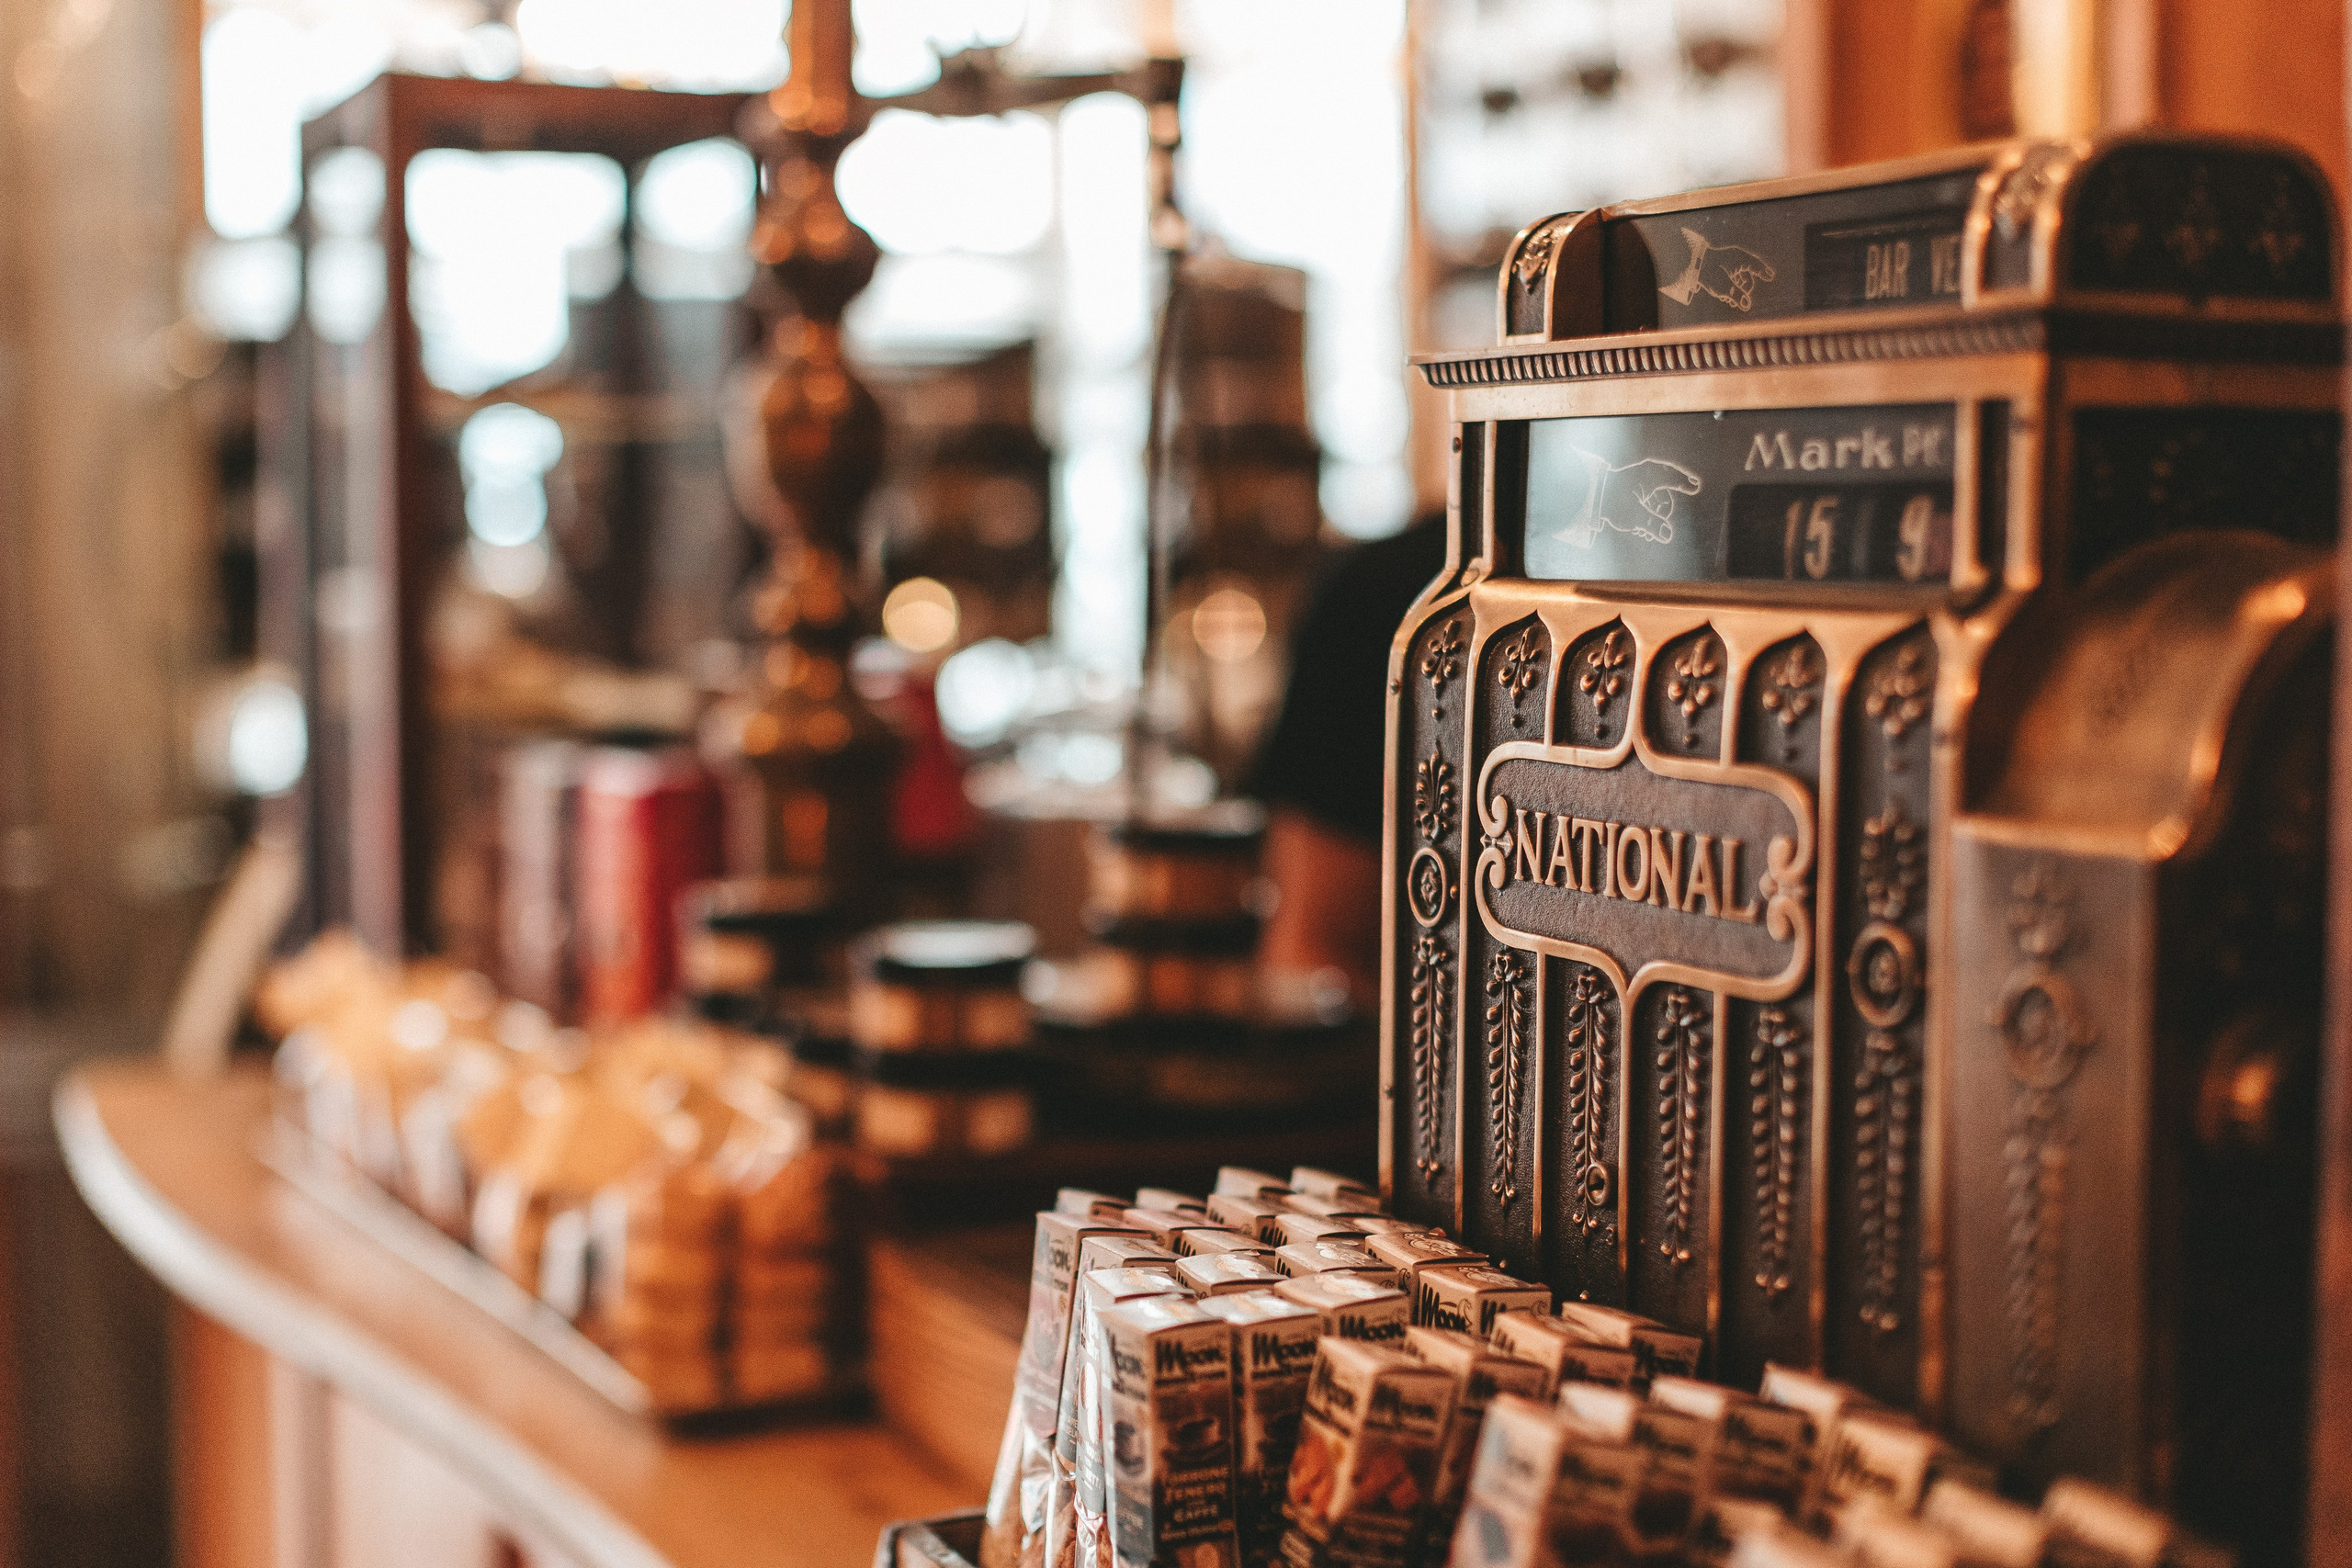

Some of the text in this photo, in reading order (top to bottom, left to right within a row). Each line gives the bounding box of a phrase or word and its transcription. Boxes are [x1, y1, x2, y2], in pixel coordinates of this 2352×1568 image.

[1744, 427, 1894, 471] Mark
[1894, 494, 1934, 581] 9
[1513, 808, 1763, 924] NATIONAL
